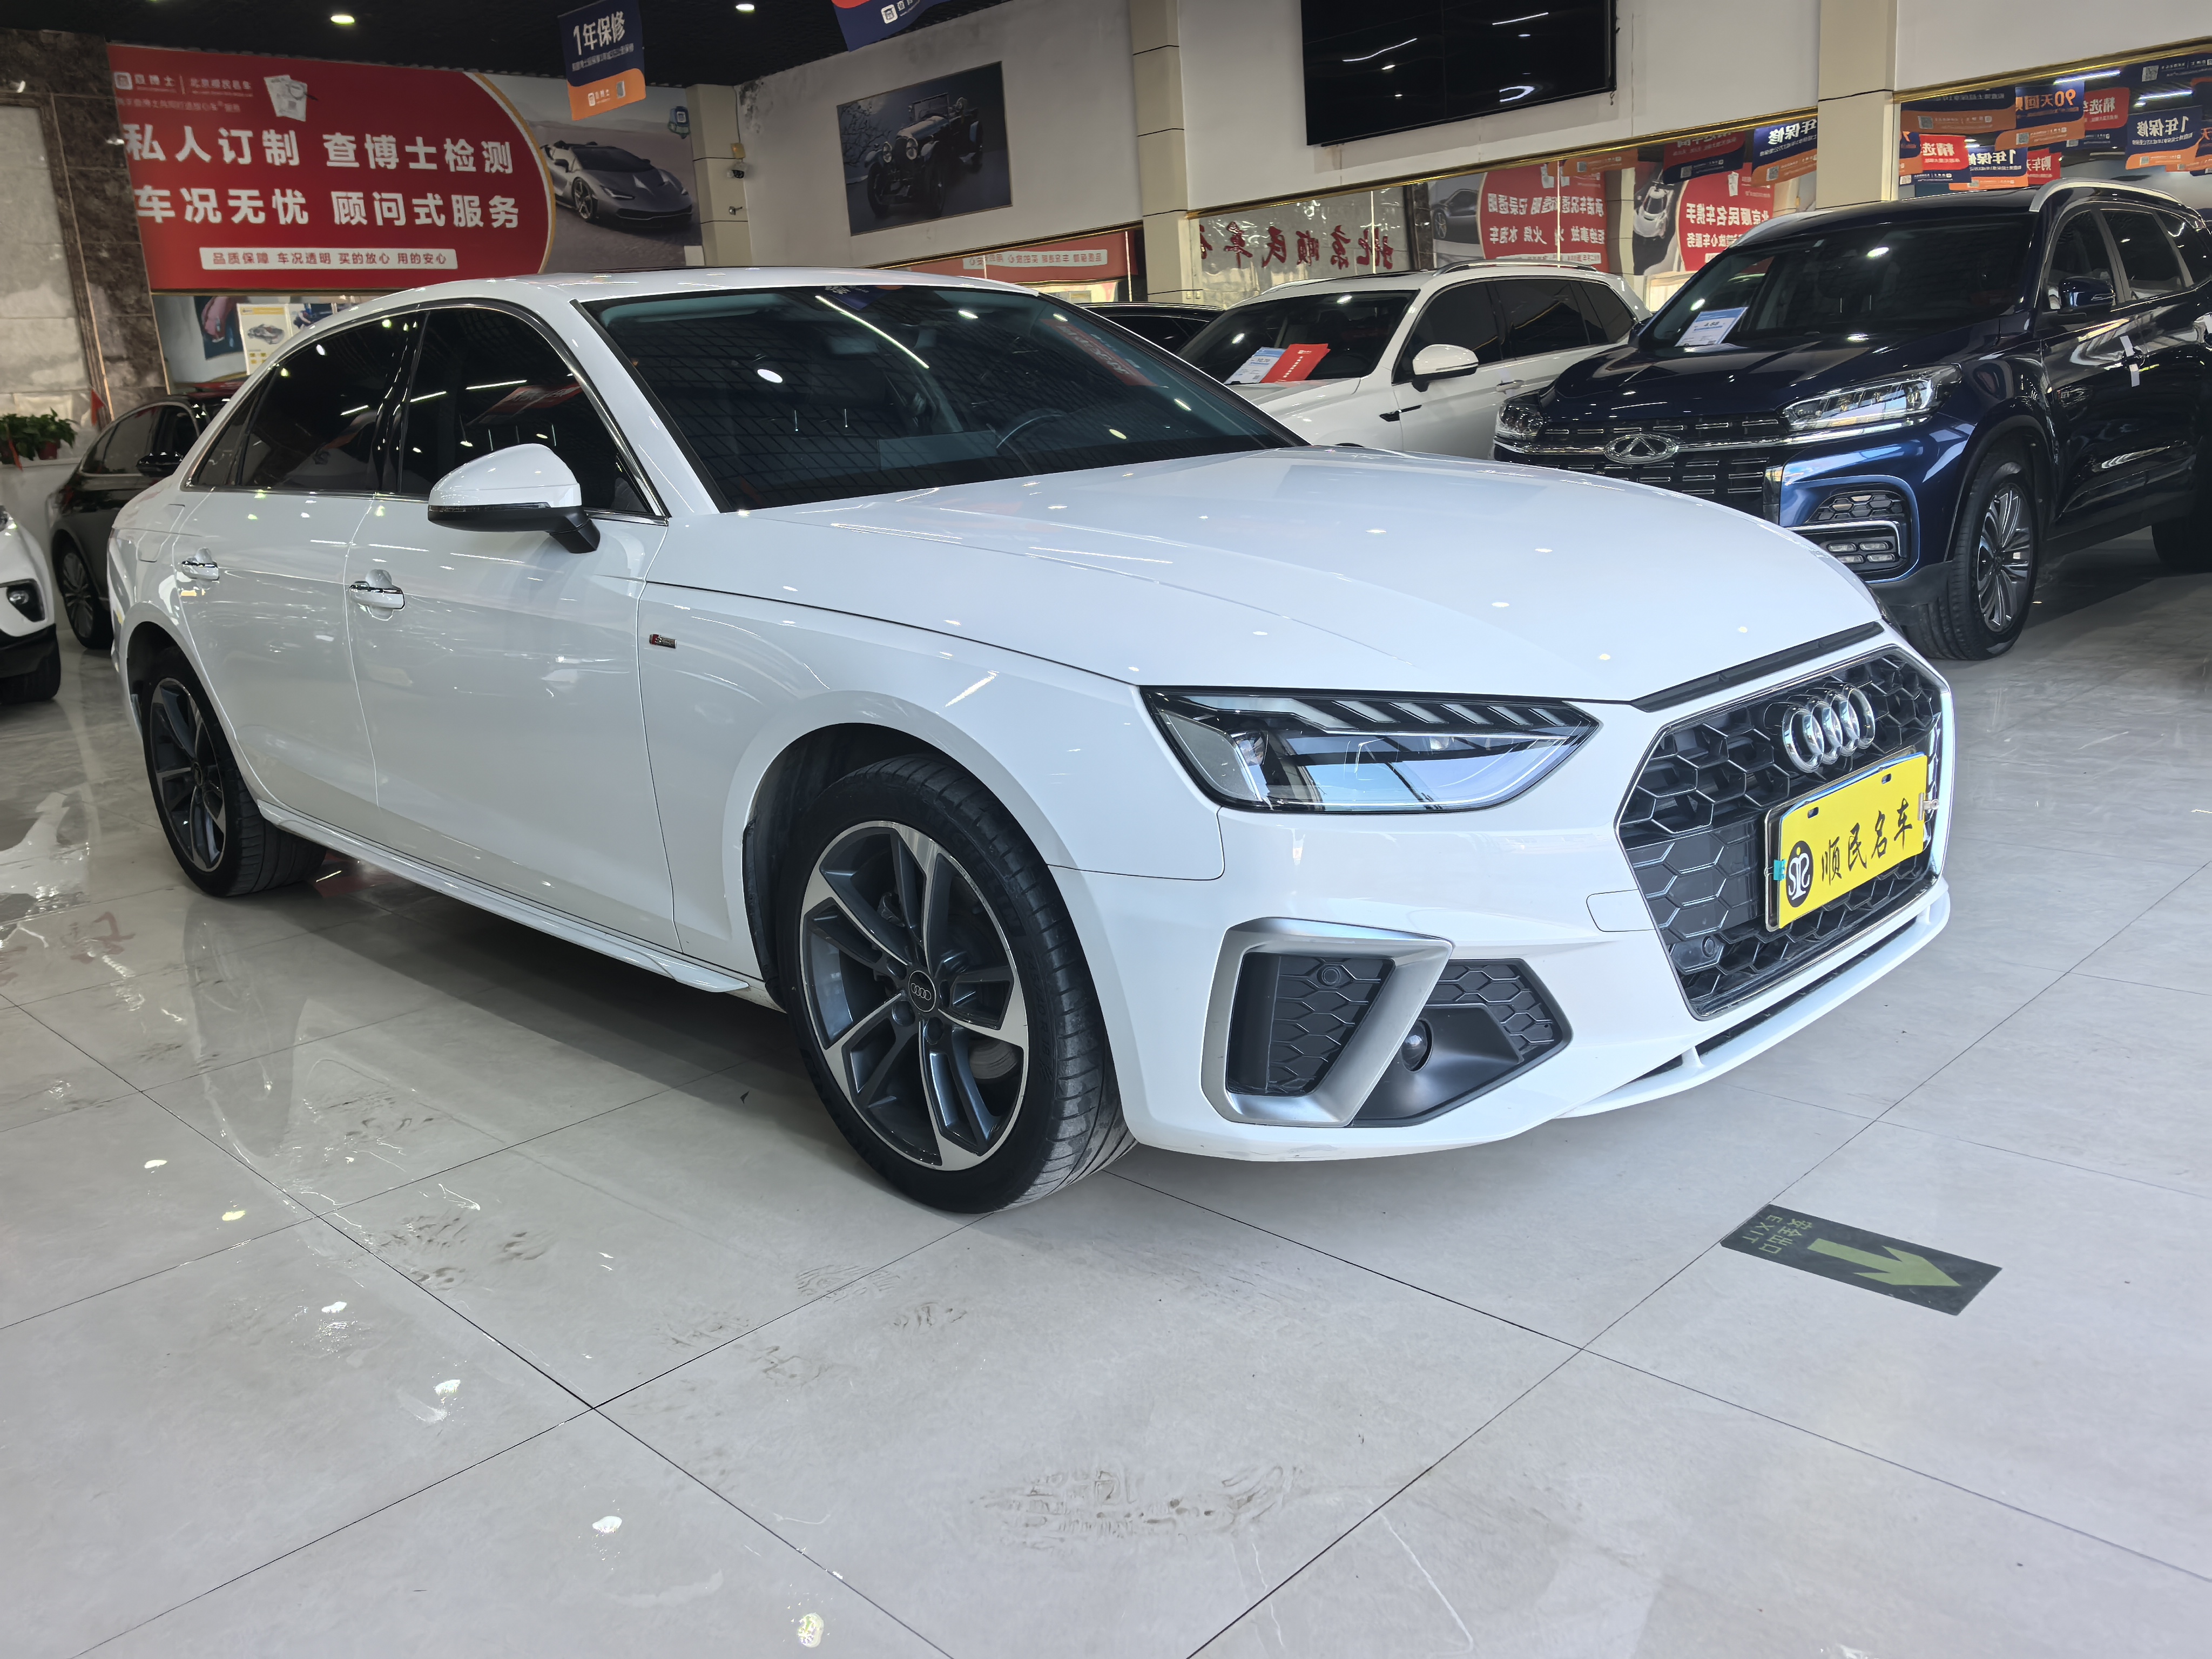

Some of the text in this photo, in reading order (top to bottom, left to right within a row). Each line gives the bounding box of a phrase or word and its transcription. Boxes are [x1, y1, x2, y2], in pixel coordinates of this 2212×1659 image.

[574, 11, 625, 55] 1年保修
[122, 123, 514, 174] 私人订制 查博士检测
[133, 185, 519, 229] 车况无忧 顾问式服务
[213, 252, 447, 265] 品质保障 车况透明 买的放心 用的安心
[1821, 797, 1913, 886] 顺民名车
[1742, 1214, 1783, 1244] EXIT
[1758, 1218, 1812, 1255] 安全出口
